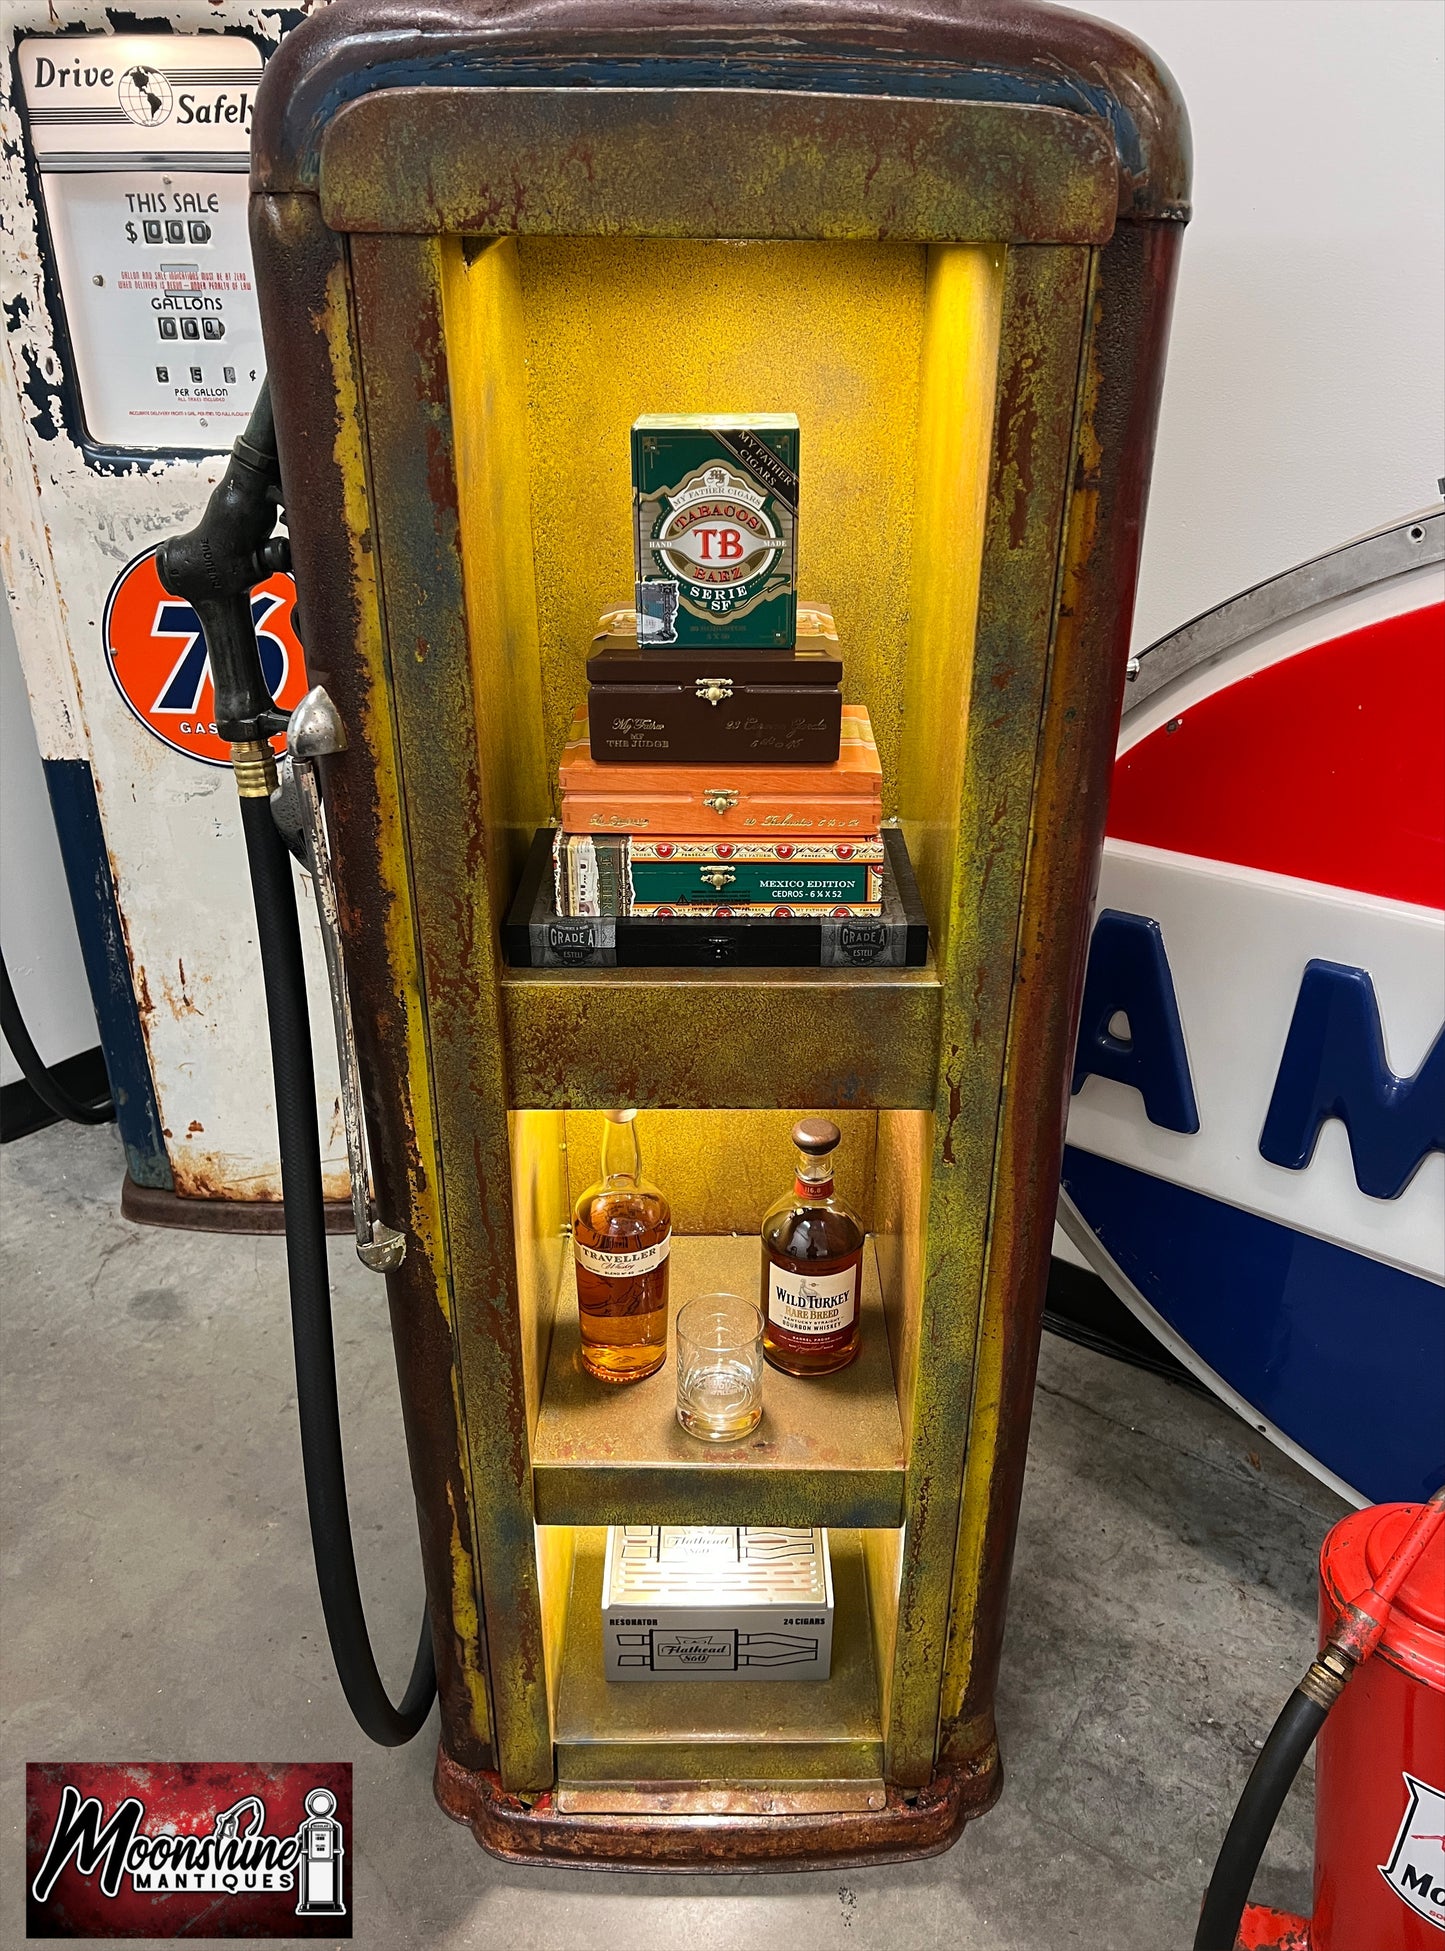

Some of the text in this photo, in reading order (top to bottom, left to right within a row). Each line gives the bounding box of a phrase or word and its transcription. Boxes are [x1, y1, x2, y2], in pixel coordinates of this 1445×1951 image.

[34, 57, 114, 88] Drive
[125, 193, 219, 213] THIS SALE
[151, 298, 223, 310] GALLONS
[174, 388, 228, 396] PER GALLON
[739, 431, 792, 486] MY FATHER
[740, 449, 776, 486] CIGARS
[672, 486, 762, 508] MY FATHER CIGARS
[674, 503, 761, 530] TABACOS
[692, 528, 744, 560] TB
[692, 567, 744, 583] BAEZ
[690, 585, 747, 600] SERIE
[711, 600, 731, 611] SF
[612, 717, 665, 734] My Father
[606, 740, 669, 748] THE JUDGE
[759, 880, 856, 888] MEXICO EDITION
[772, 890, 804, 898] CEDROS
[810, 890, 815, 898] 6
[824, 890, 831, 898] X
[832, 890, 842, 898] 52
[550, 928, 595, 947] GRADE A
[842, 928, 886, 946] GRADE A
[853, 949, 873, 957] ESTELI
[582, 1247, 657, 1263] TRAVELLER
[776, 1285, 850, 1309] WILD TURKEY
[785, 1305, 839, 1320] RARE BREED
[782, 1320, 841, 1331] BOURBON WHISKEY
[784, 1316, 840, 1325] KENTUCKY STRAIGHT
[609, 1618, 658, 1626] RESONATOR
[795, 1617, 825, 1626] CIGARS
[661, 1645, 727, 1655] Flathead
